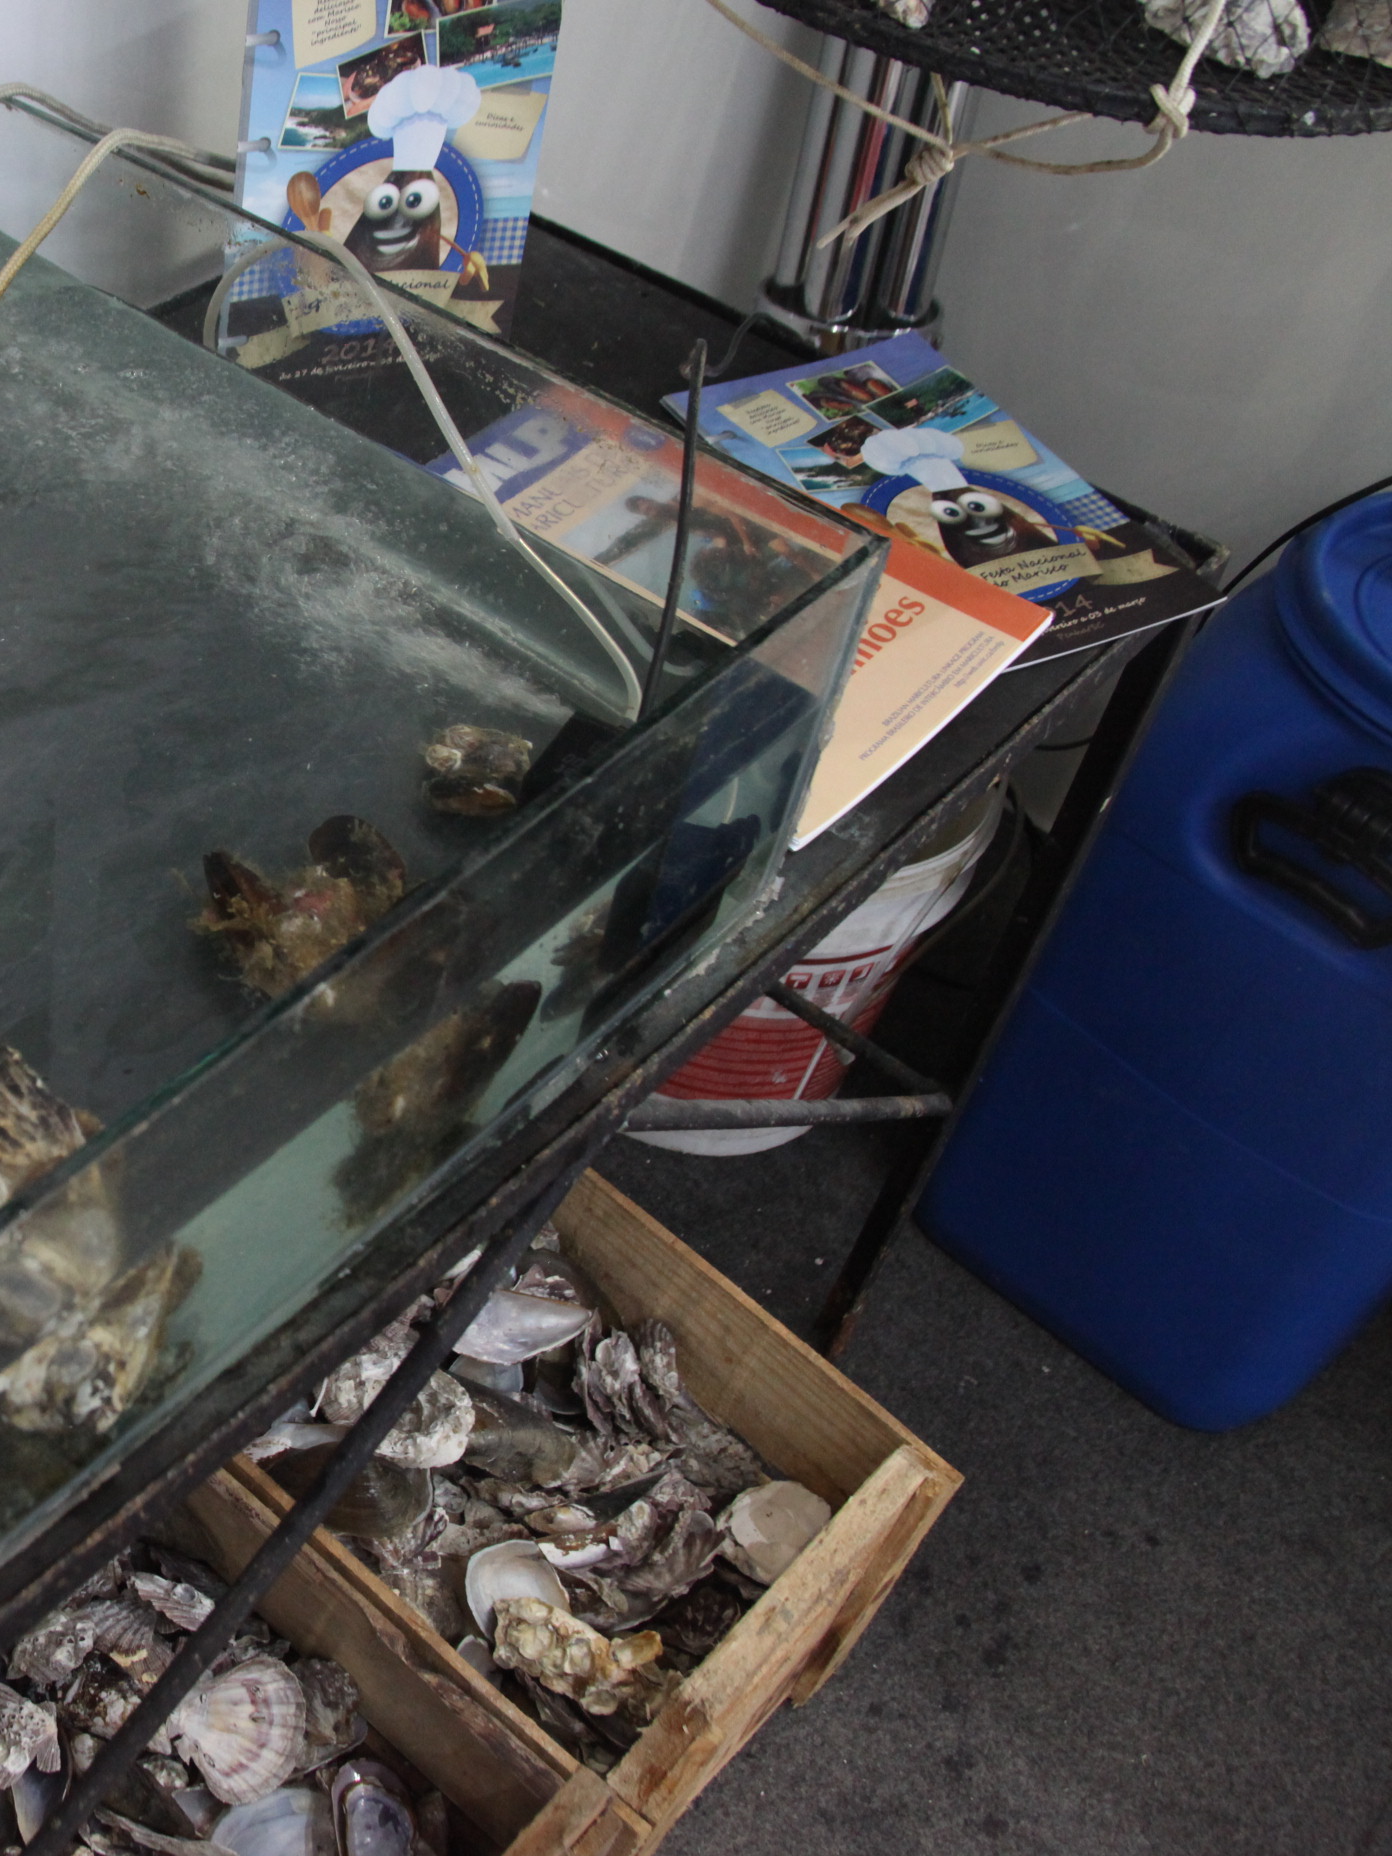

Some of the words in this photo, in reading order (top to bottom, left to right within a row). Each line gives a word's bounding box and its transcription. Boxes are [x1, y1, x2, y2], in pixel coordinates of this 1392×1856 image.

[325, 15, 347, 26] Nosso
[475, 120, 525, 132] curiosidades
[294, 368, 308, 378] 27
[980, 566, 1016, 582] Festa
[1018, 549, 1087, 569] Nacional
[1011, 564, 1069, 583] Marisco
[1104, 607, 1117, 615] de
[1117, 597, 1147, 609] março
[882, 701, 910, 728] BRAZILIAN
[886, 709, 916, 738] BRASILEIRO
